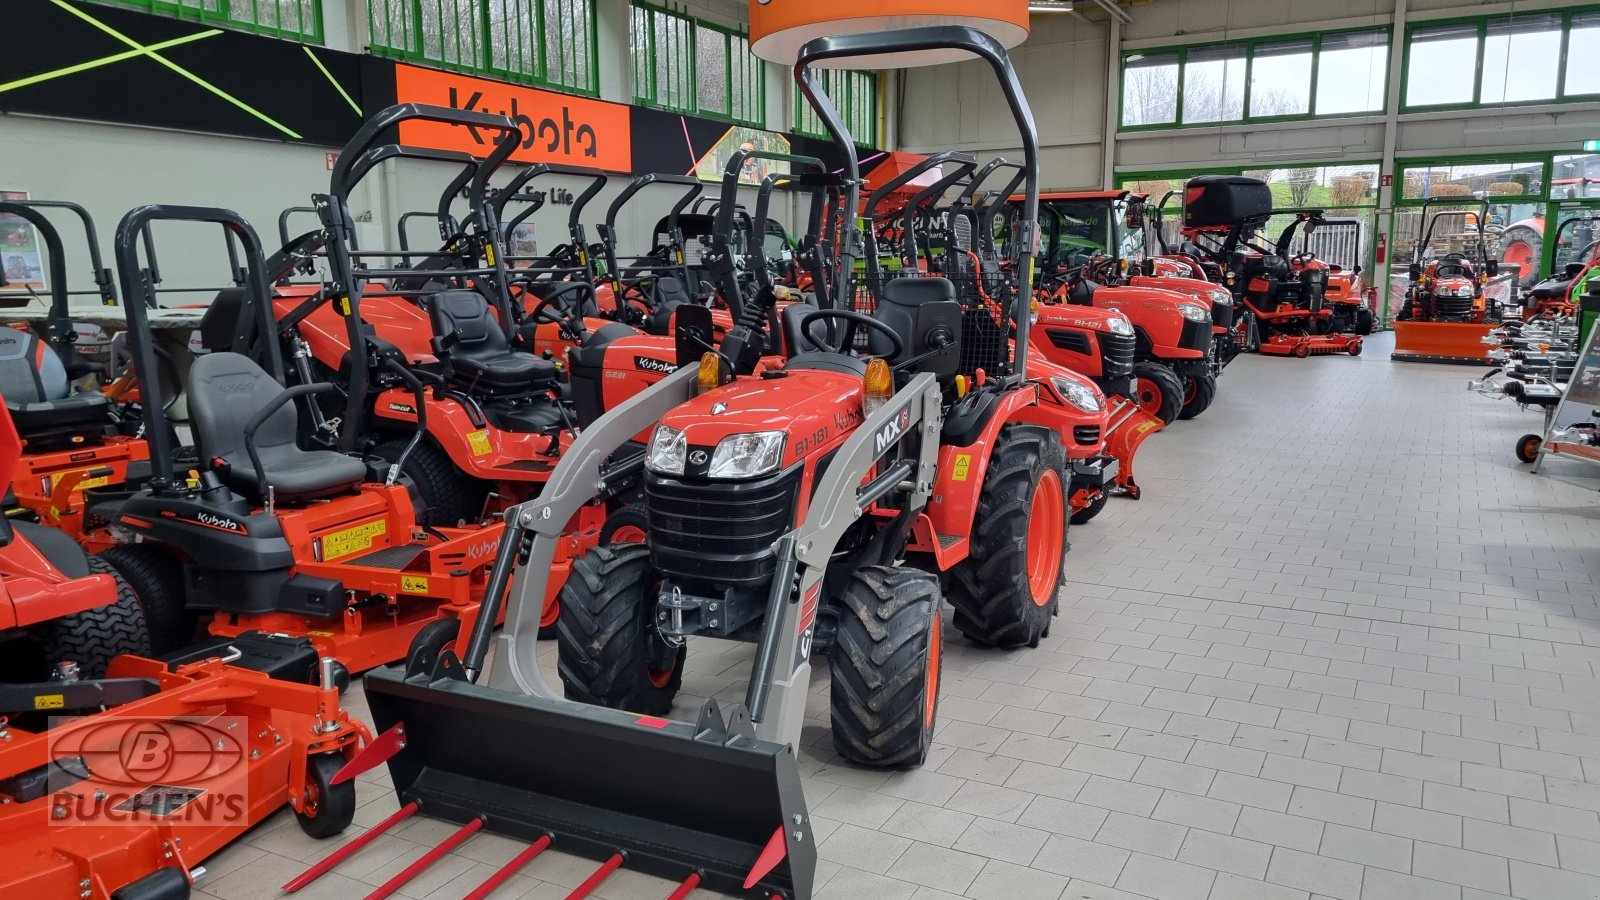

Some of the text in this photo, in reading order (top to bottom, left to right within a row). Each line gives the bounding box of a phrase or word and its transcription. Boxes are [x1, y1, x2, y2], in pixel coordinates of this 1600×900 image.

[550, 188, 573, 205] Life
[795, 426, 829, 457] B1-181
[876, 415, 901, 453] MX
[197, 512, 237, 530] Kubota
